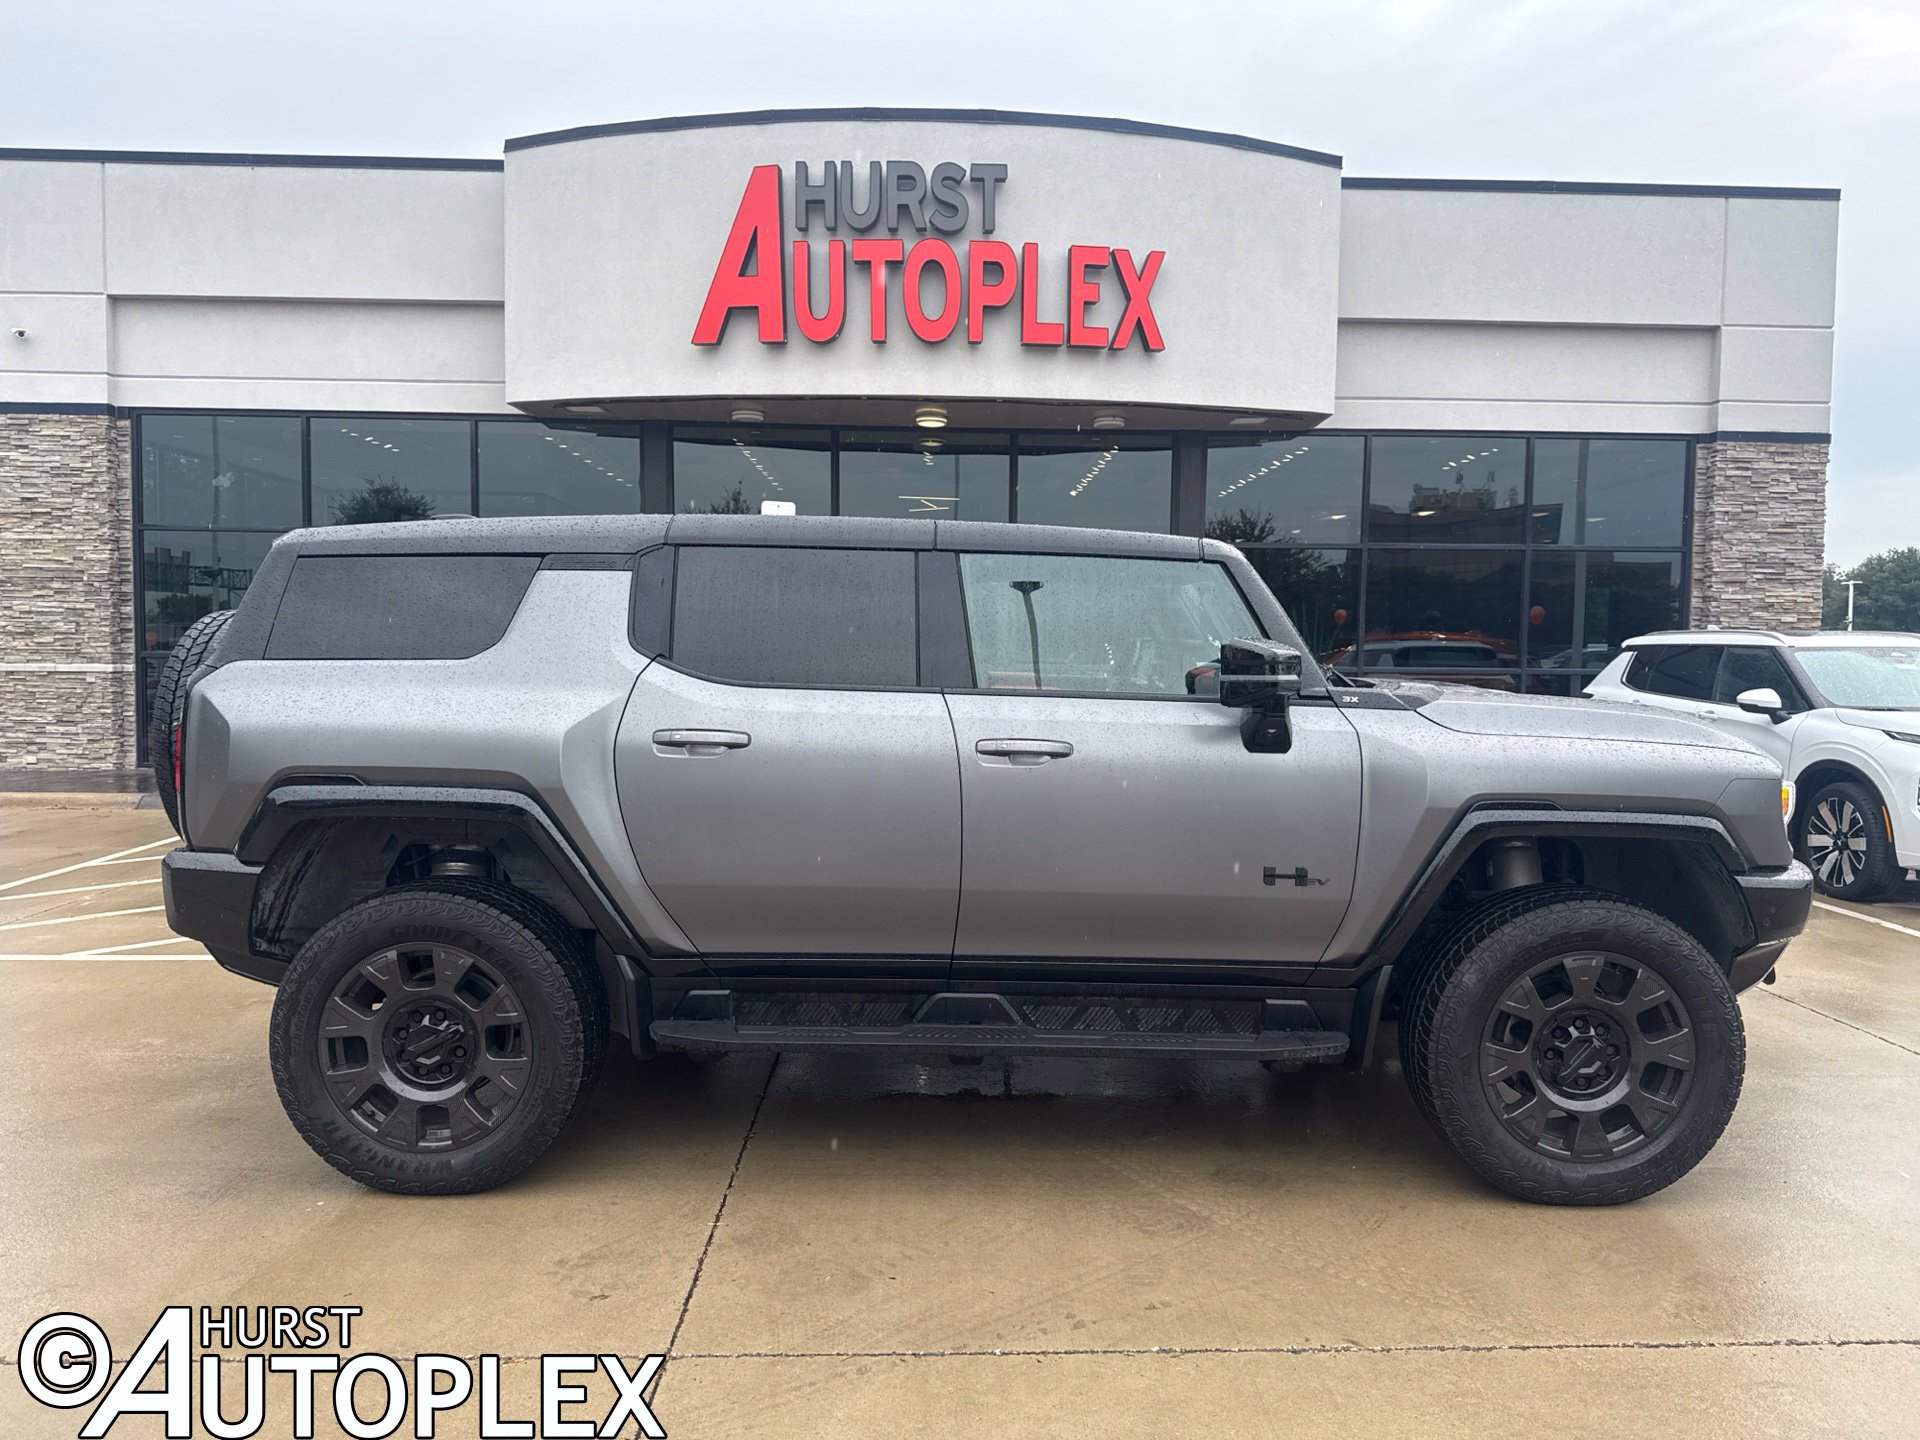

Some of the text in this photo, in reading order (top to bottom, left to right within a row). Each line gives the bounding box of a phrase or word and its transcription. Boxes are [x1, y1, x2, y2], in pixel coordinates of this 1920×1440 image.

[795, 160, 1008, 234] HURST
[691, 164, 1166, 352] AUTOPLEX
[1341, 695, 1360, 704] 3X
